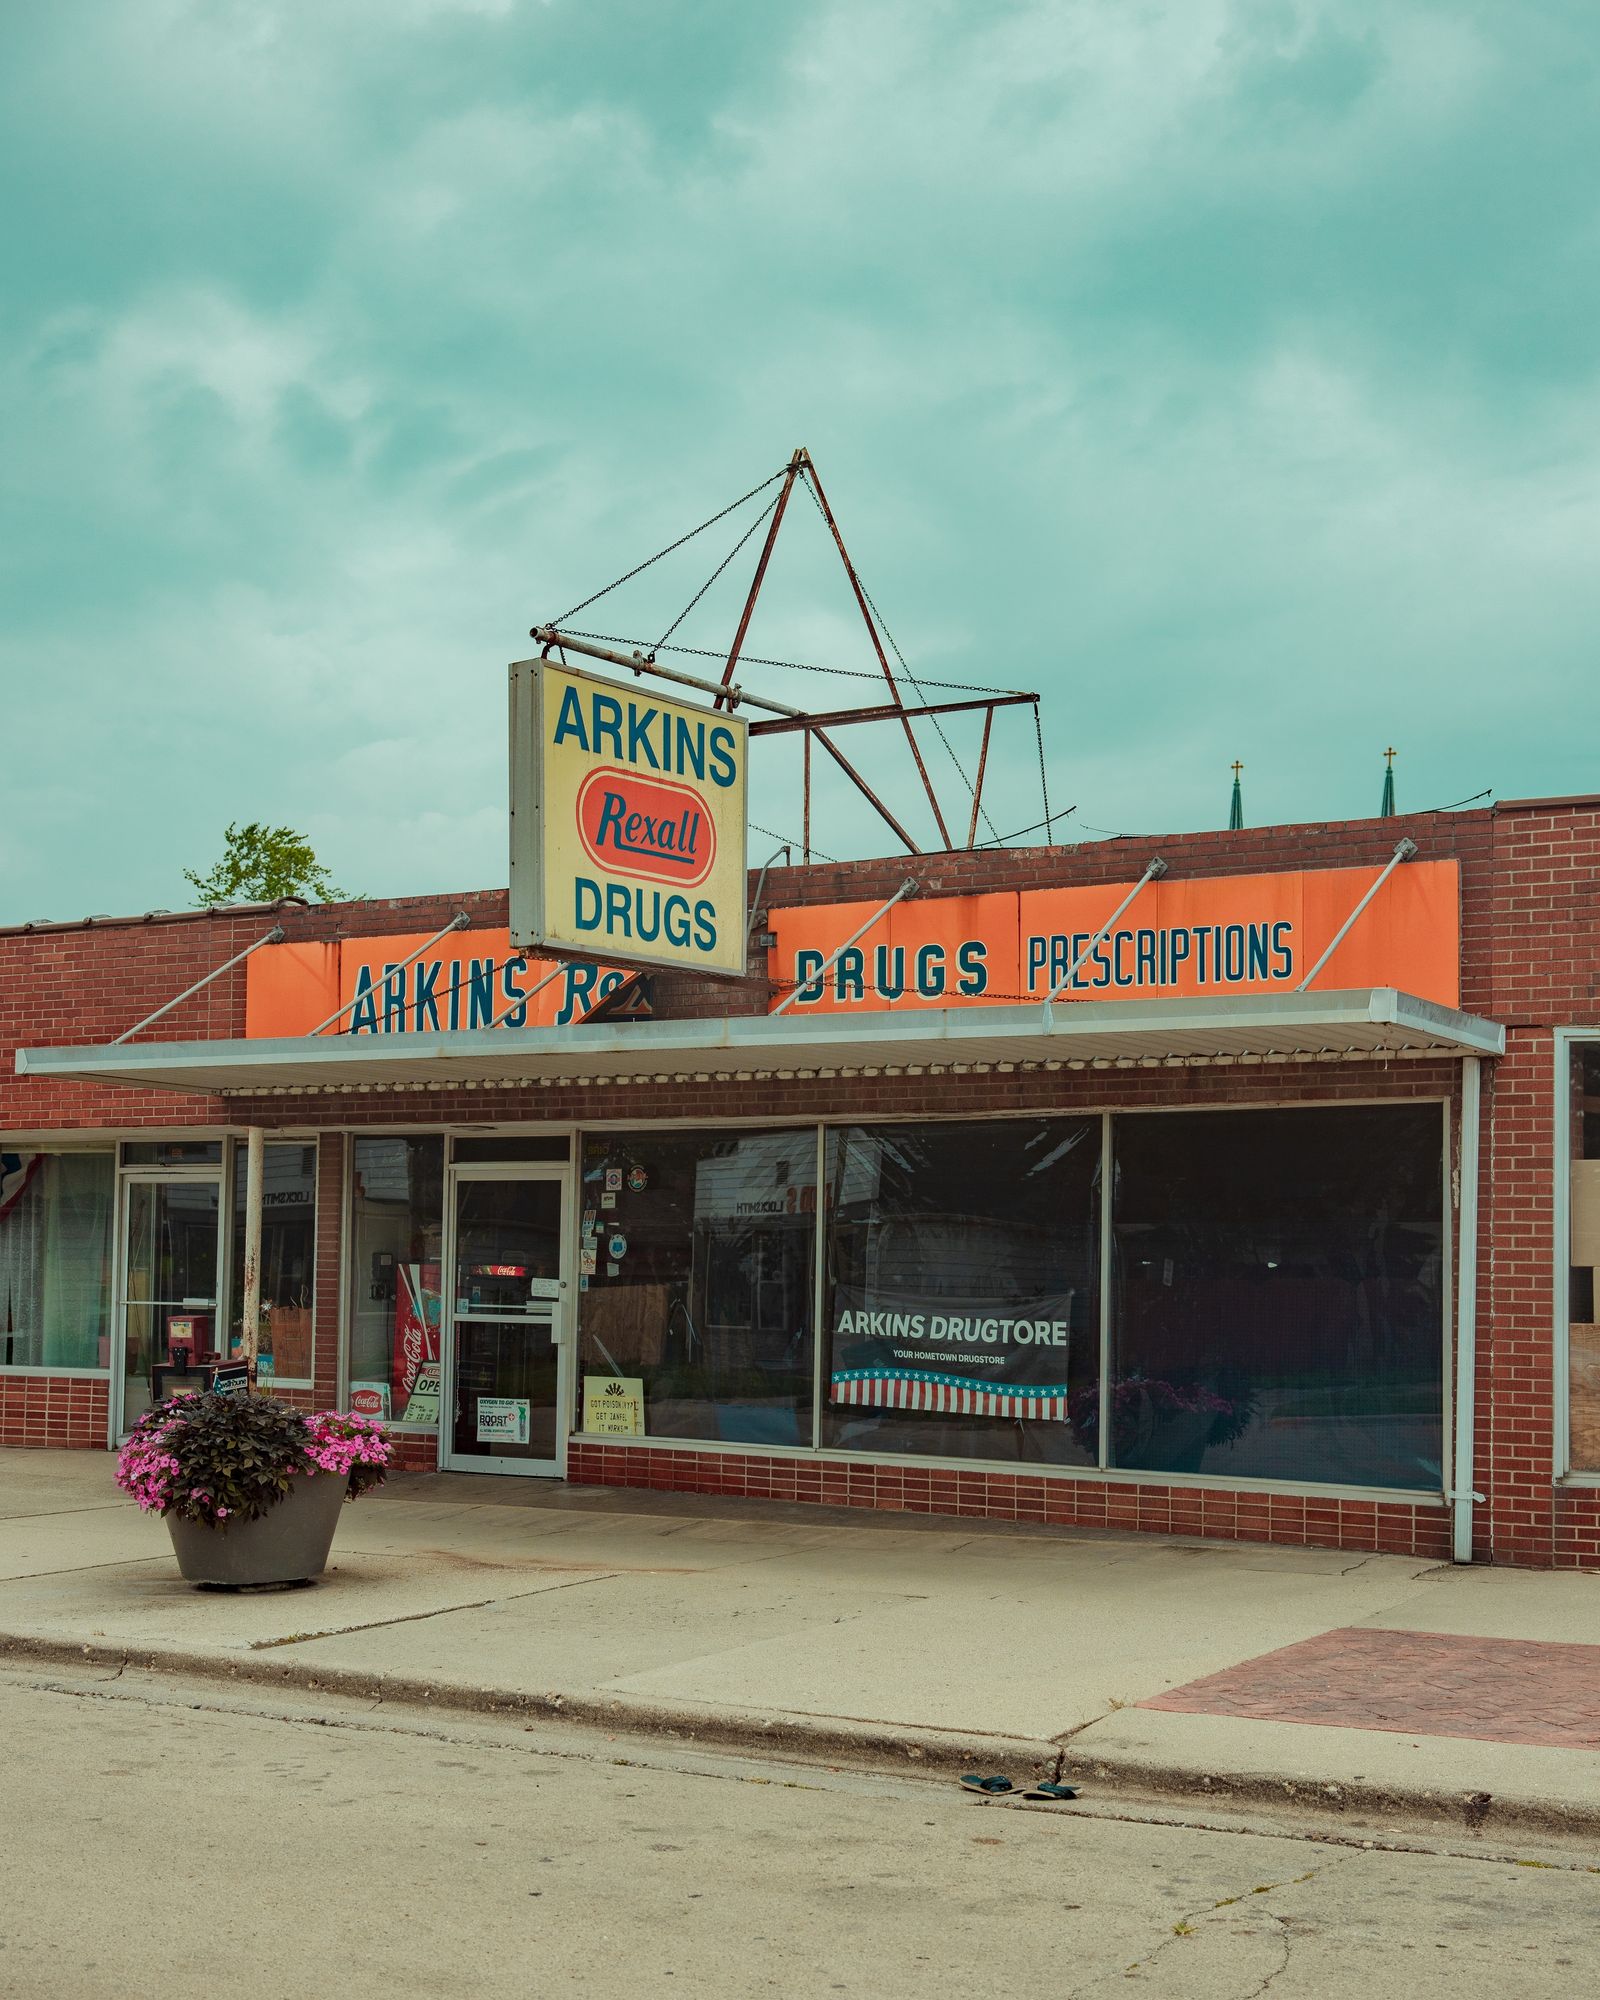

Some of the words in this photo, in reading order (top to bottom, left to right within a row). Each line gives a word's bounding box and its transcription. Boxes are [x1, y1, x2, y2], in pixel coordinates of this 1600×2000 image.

[553, 685, 737, 787] ARKINS
[595, 791, 700, 864] Rexall
[575, 876, 717, 951] DRUGS
[350, 955, 528, 1035] ARKINS
[795, 941, 988, 1004] DRUGS
[1027, 921, 1294, 991] PRESCRIPTIONS
[837, 1310, 926, 1339] ARKINS
[929, 1316, 1067, 1346] DRUGTORE
[893, 1349, 914, 1359] YOUR
[914, 1351, 957, 1362] HOMETOWN
[958, 1354, 1005, 1365] DRUGSTORE
